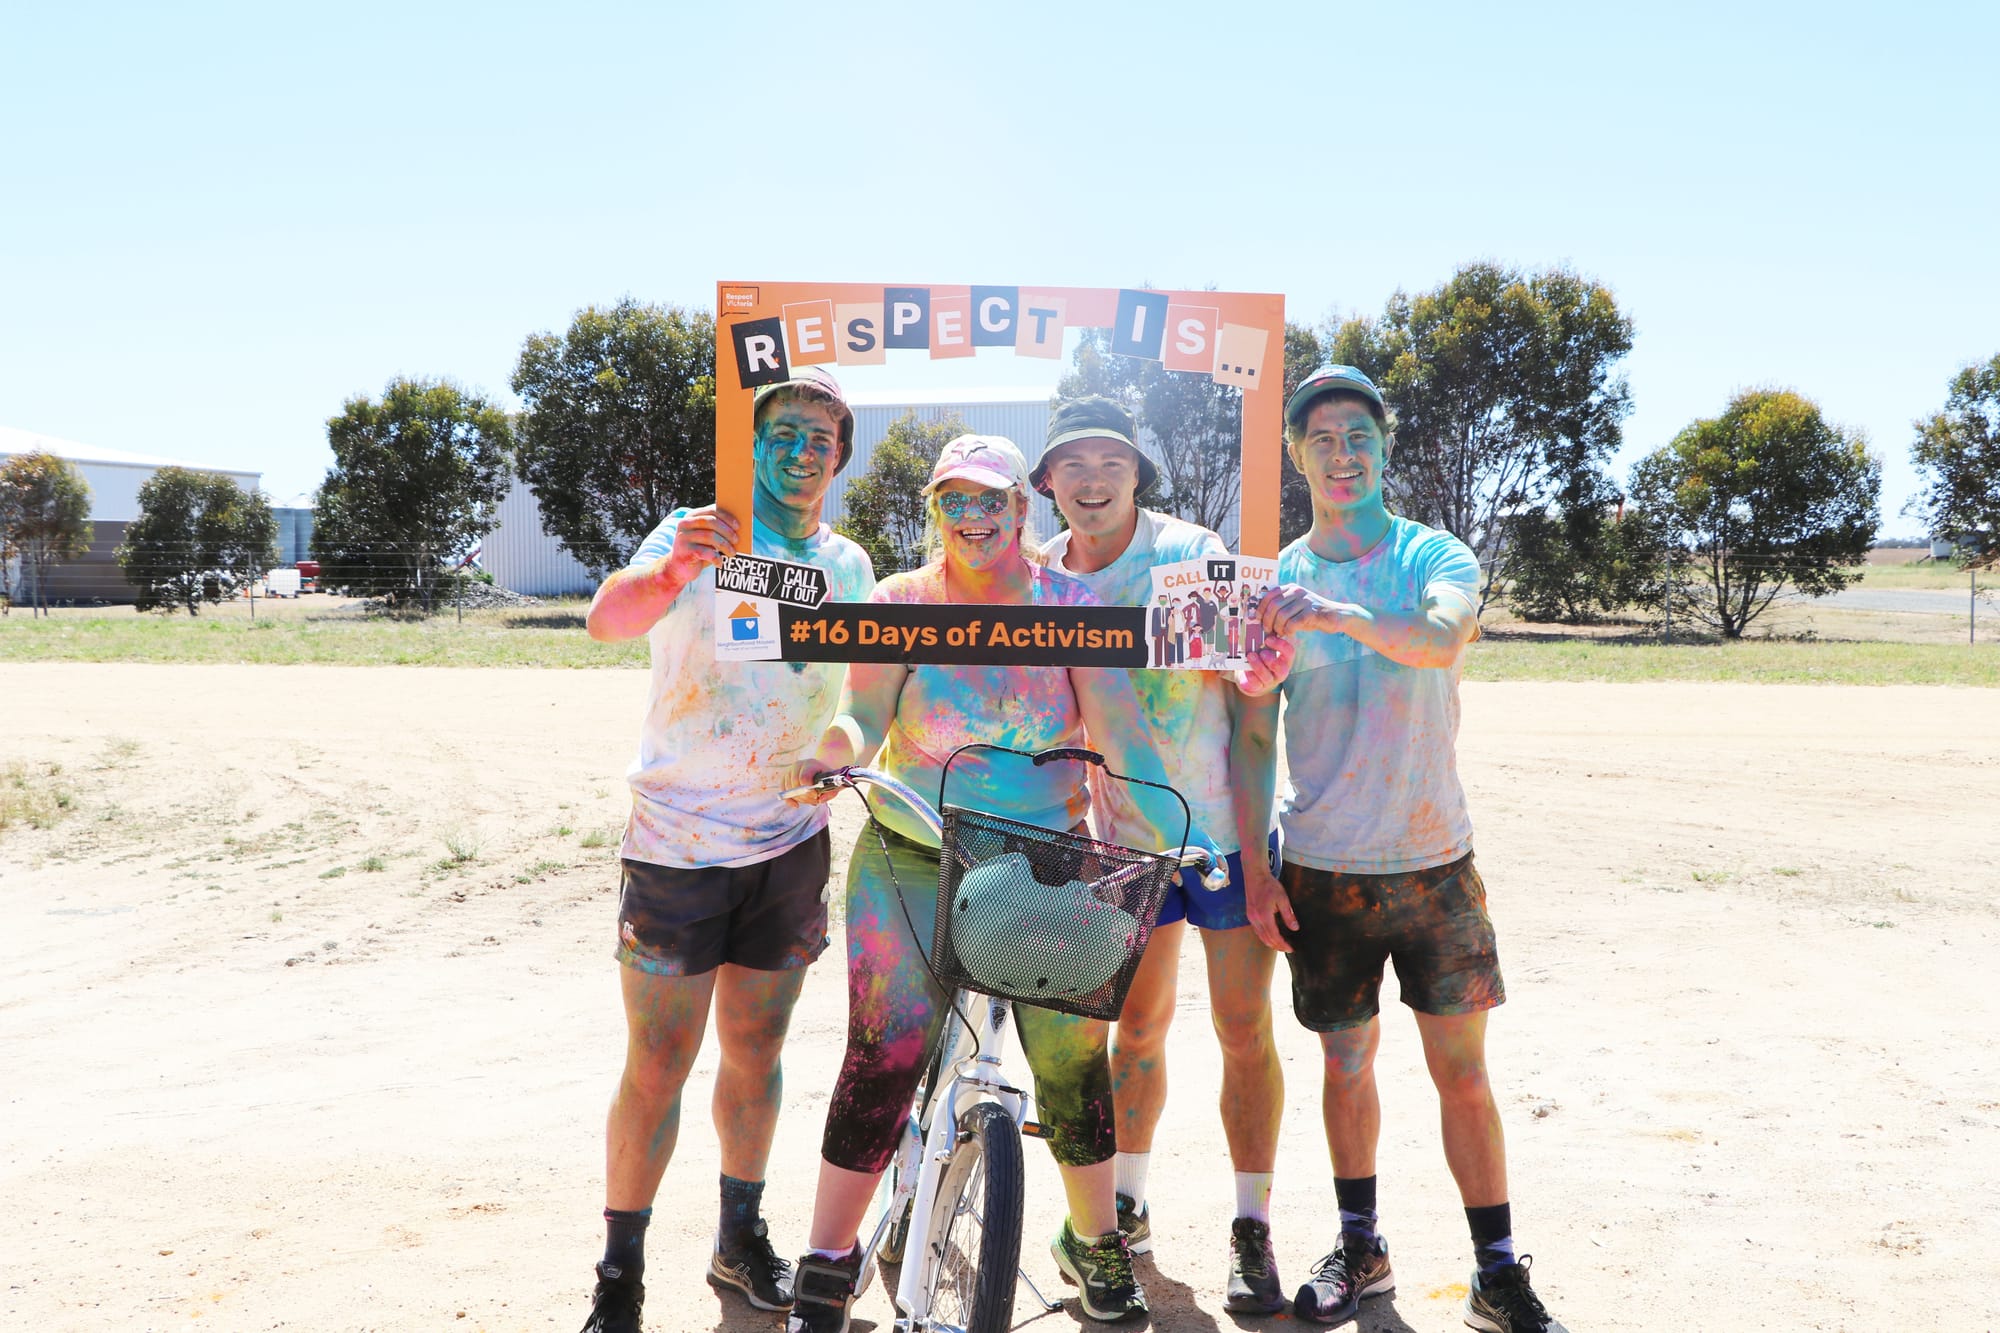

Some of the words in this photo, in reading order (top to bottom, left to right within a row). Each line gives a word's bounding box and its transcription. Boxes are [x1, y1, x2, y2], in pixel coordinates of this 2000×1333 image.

[745, 296, 1058, 373] RESPECT
[720, 555, 774, 578] RESPECT
[783, 567, 819, 590] CALL
[1163, 571, 1206, 588] CALL
[1213, 564, 1230, 578] IT
[1240, 566, 1274, 581] OUT
[717, 569, 769, 595] WOMEN
[780, 584, 790, 599] IT
[794, 586, 818, 604] OUT
[789, 619, 850, 645] #16
[858, 619, 938, 652] Days
[945, 620, 982, 647] of
[987, 620, 1134, 649] Activism
